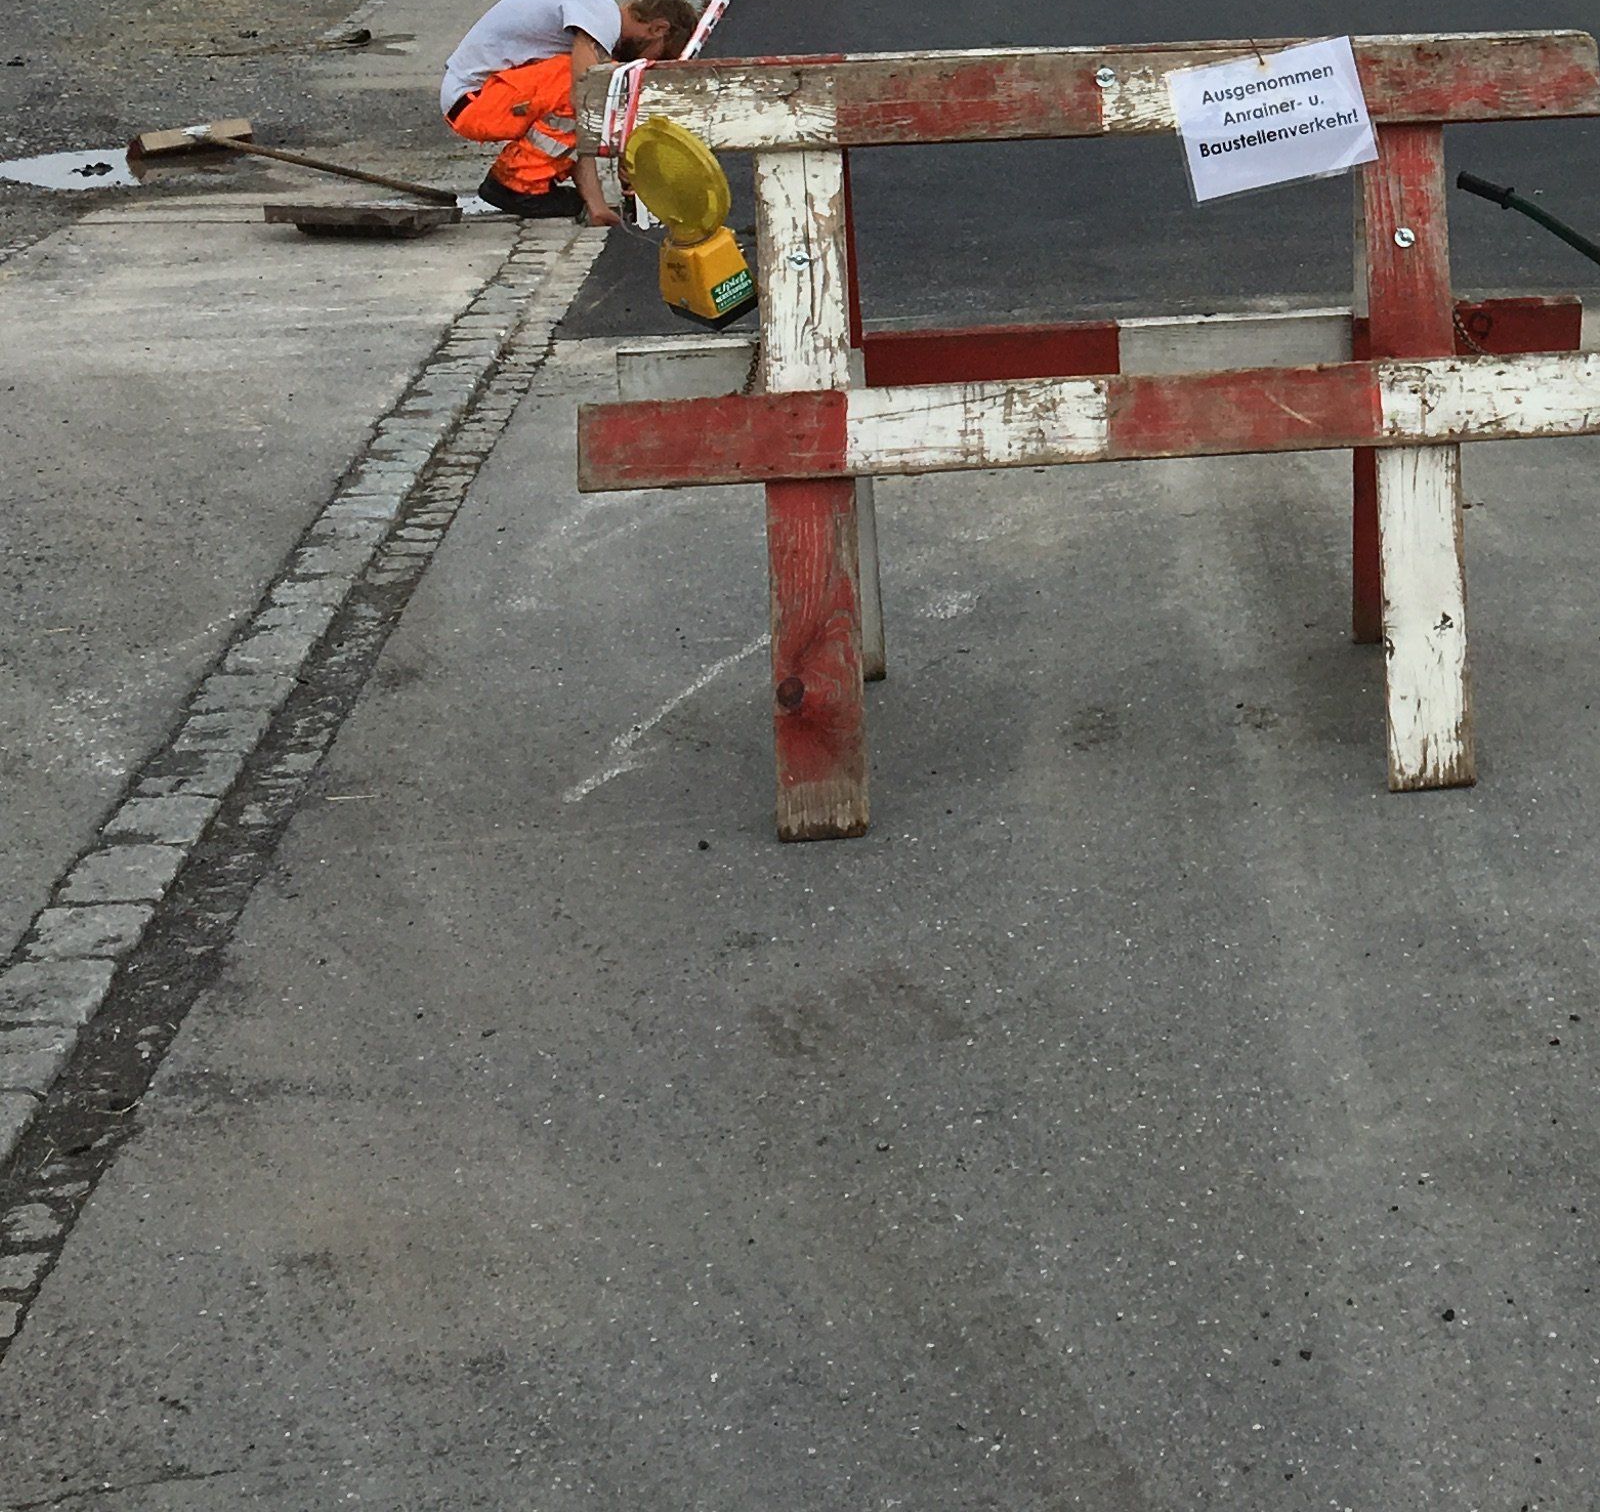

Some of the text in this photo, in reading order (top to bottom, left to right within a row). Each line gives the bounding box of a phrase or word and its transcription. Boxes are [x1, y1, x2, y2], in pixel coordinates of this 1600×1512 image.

[1202, 64, 1334, 105] Ausgenommen
[1223, 95, 1324, 127] Anrainer- u.
[1199, 109, 1359, 158] Baustellenverkehr!
